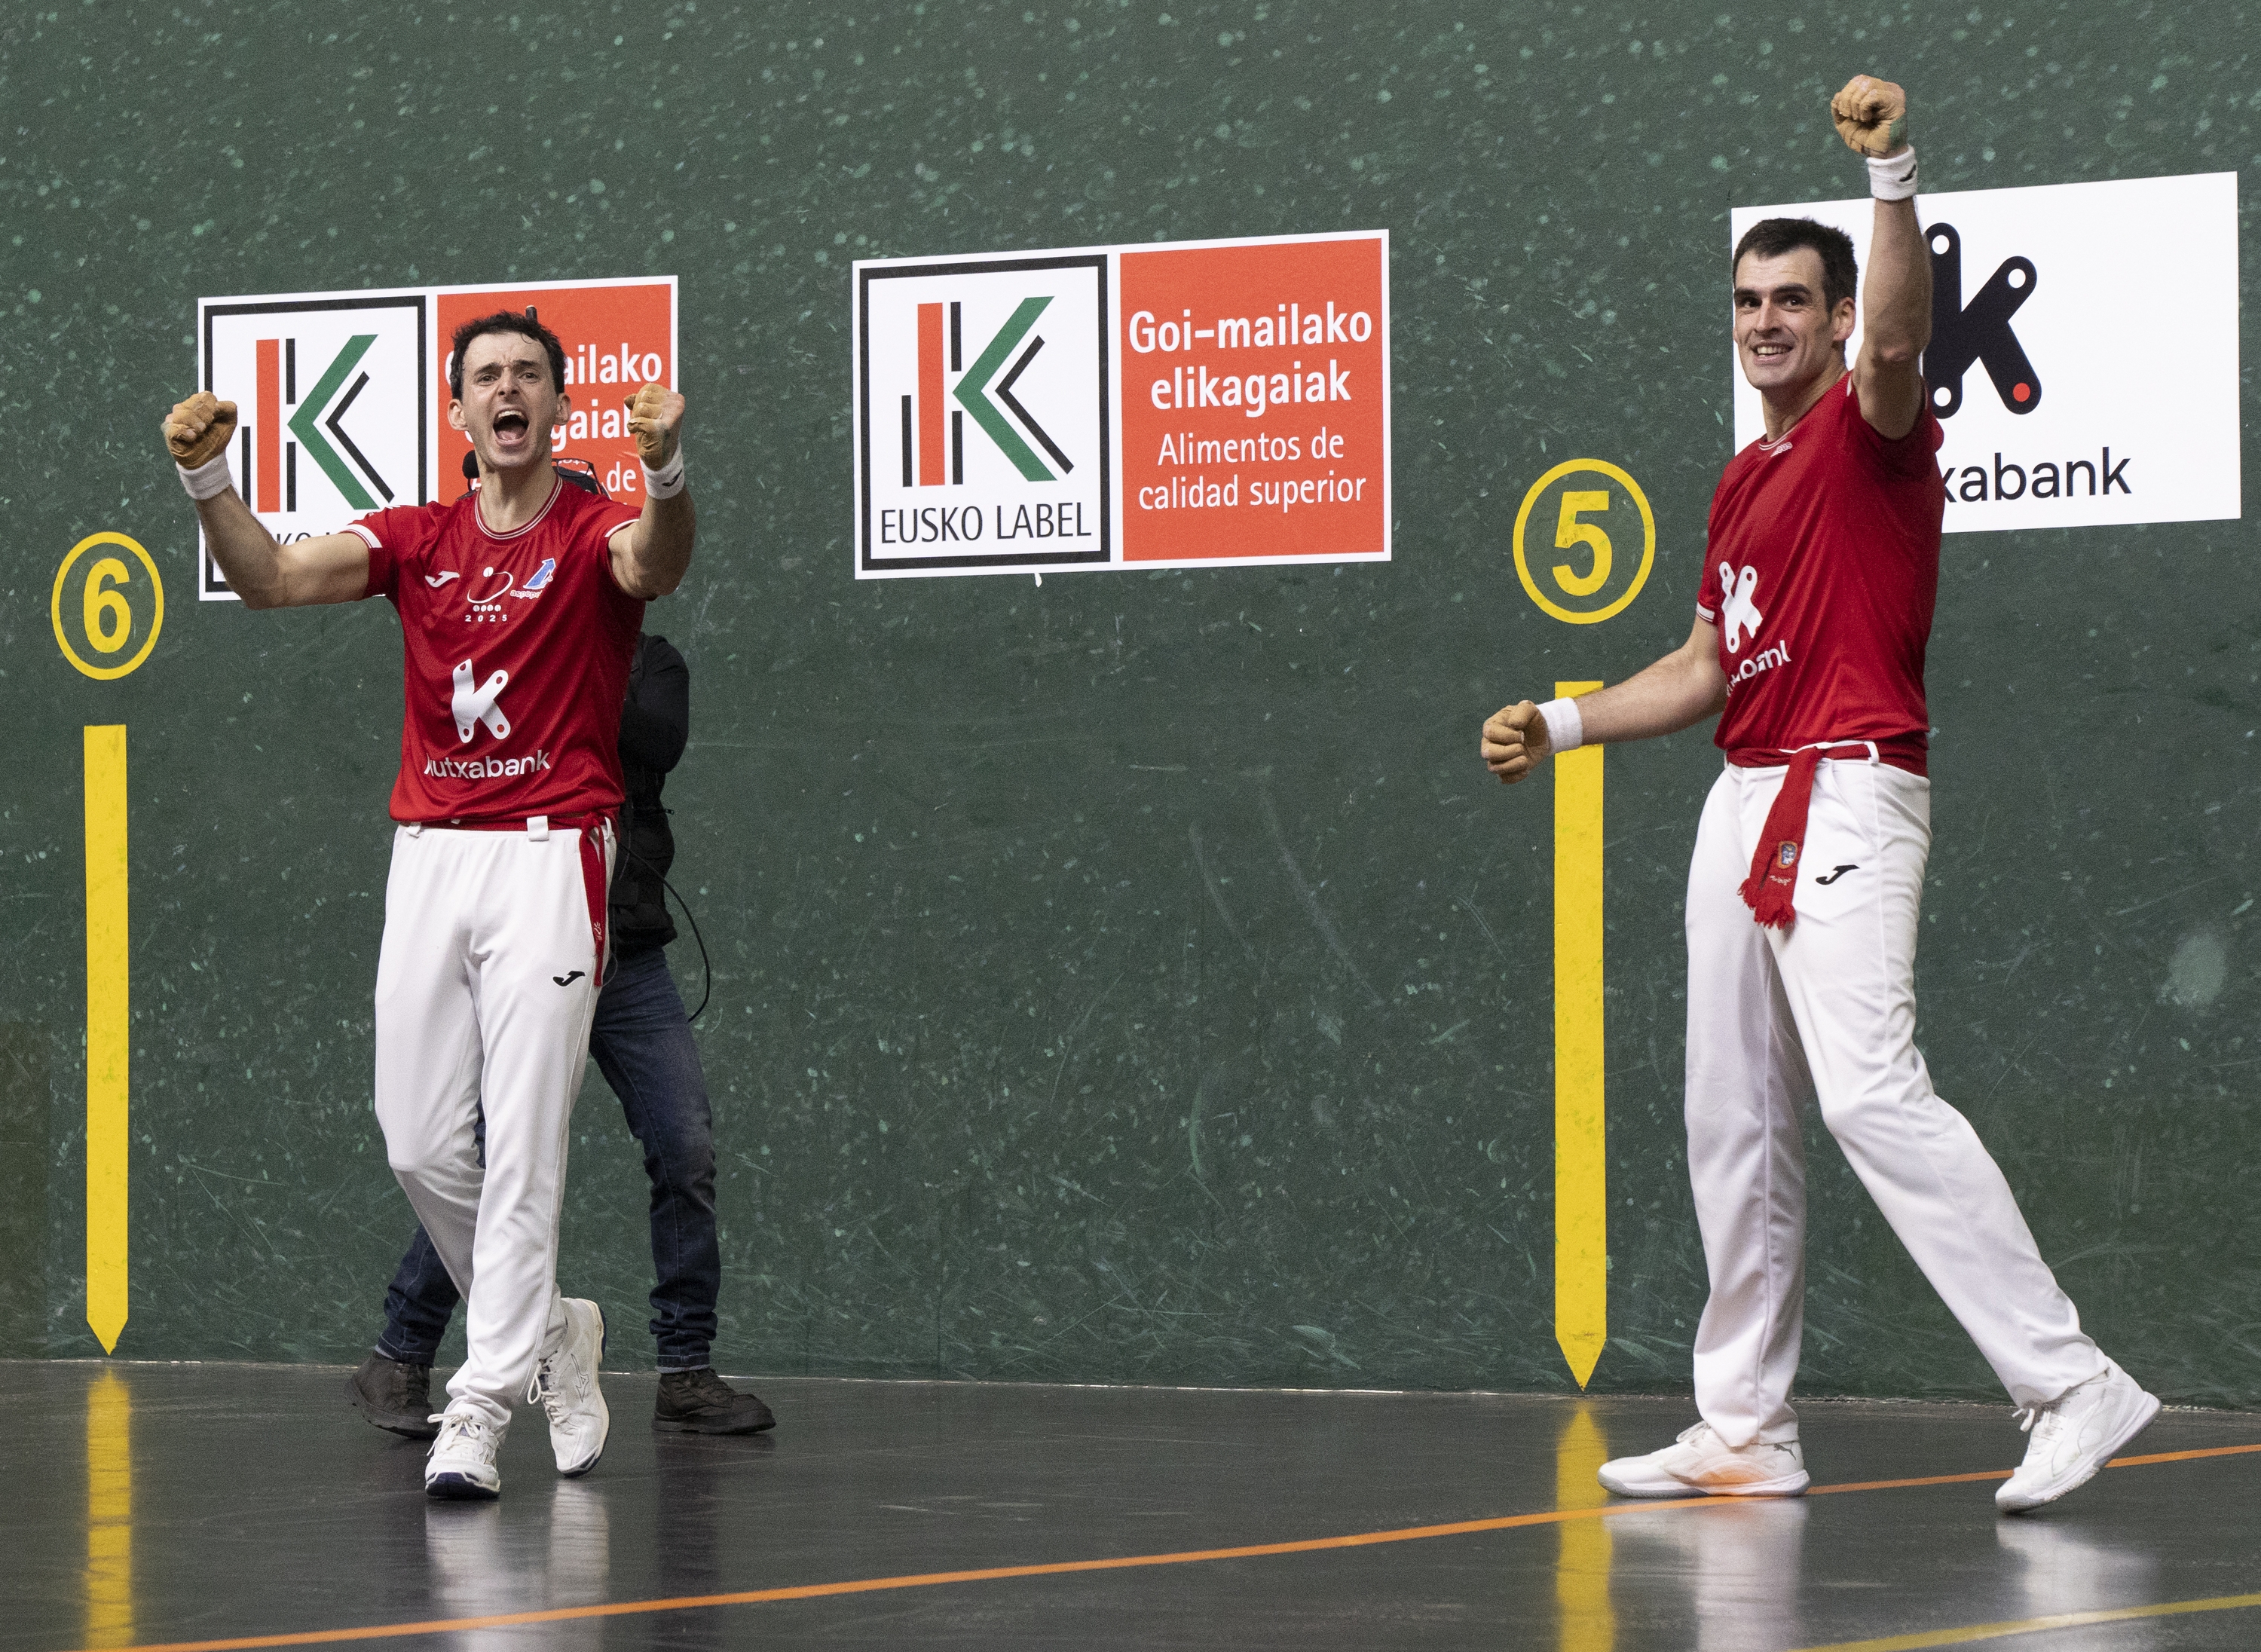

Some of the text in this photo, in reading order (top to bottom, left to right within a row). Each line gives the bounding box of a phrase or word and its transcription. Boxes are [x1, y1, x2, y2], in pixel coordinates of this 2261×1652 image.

[1129, 301, 1372, 353] Goi-mailako
[1152, 359, 1351, 418] elikagaiak
[1158, 427, 1344, 465] Alimentos de
[606, 461, 637, 493] de
[1139, 470, 1366, 512] calidad superior
[1941, 447, 2132, 503] xabank
[881, 503, 1091, 543] EUSKO LABEL
[1553, 491, 1613, 597] 5
[83, 558, 133, 653] 6
[465, 614, 507, 623] 2025
